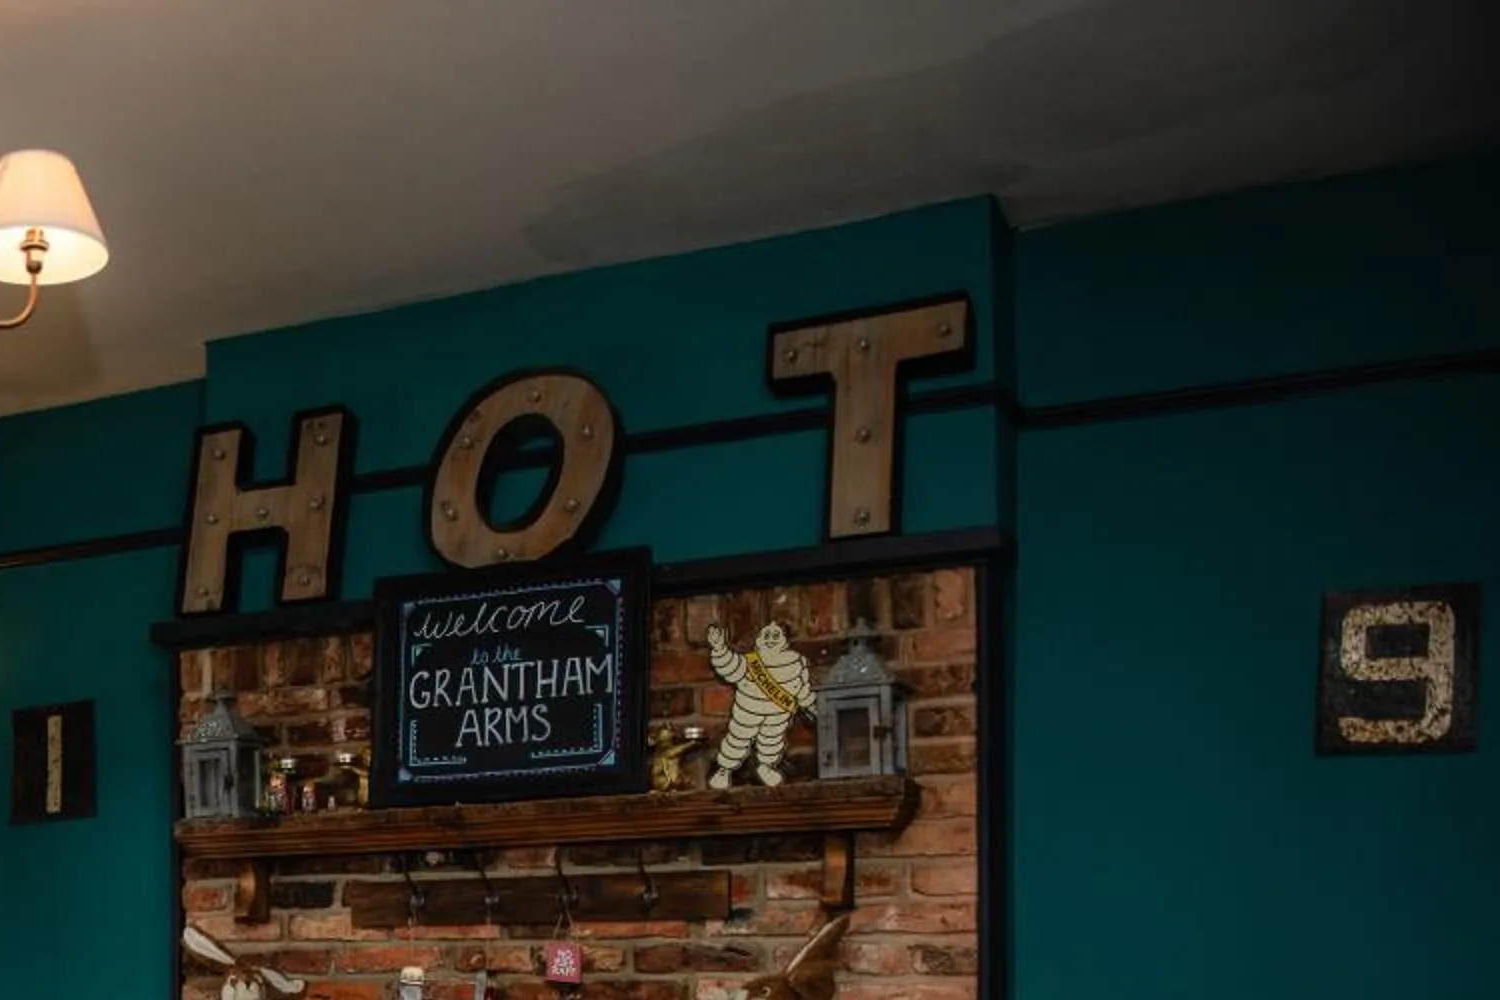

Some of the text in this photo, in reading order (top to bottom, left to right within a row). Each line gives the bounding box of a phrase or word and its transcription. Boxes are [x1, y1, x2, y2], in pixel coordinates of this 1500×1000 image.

[176, 291, 977, 616] HOT
[409, 653, 614, 709] GRANTHAM
[748, 659, 794, 707] MICHELIN
[1339, 600, 1457, 744] 9
[455, 703, 551, 748] ARMS
